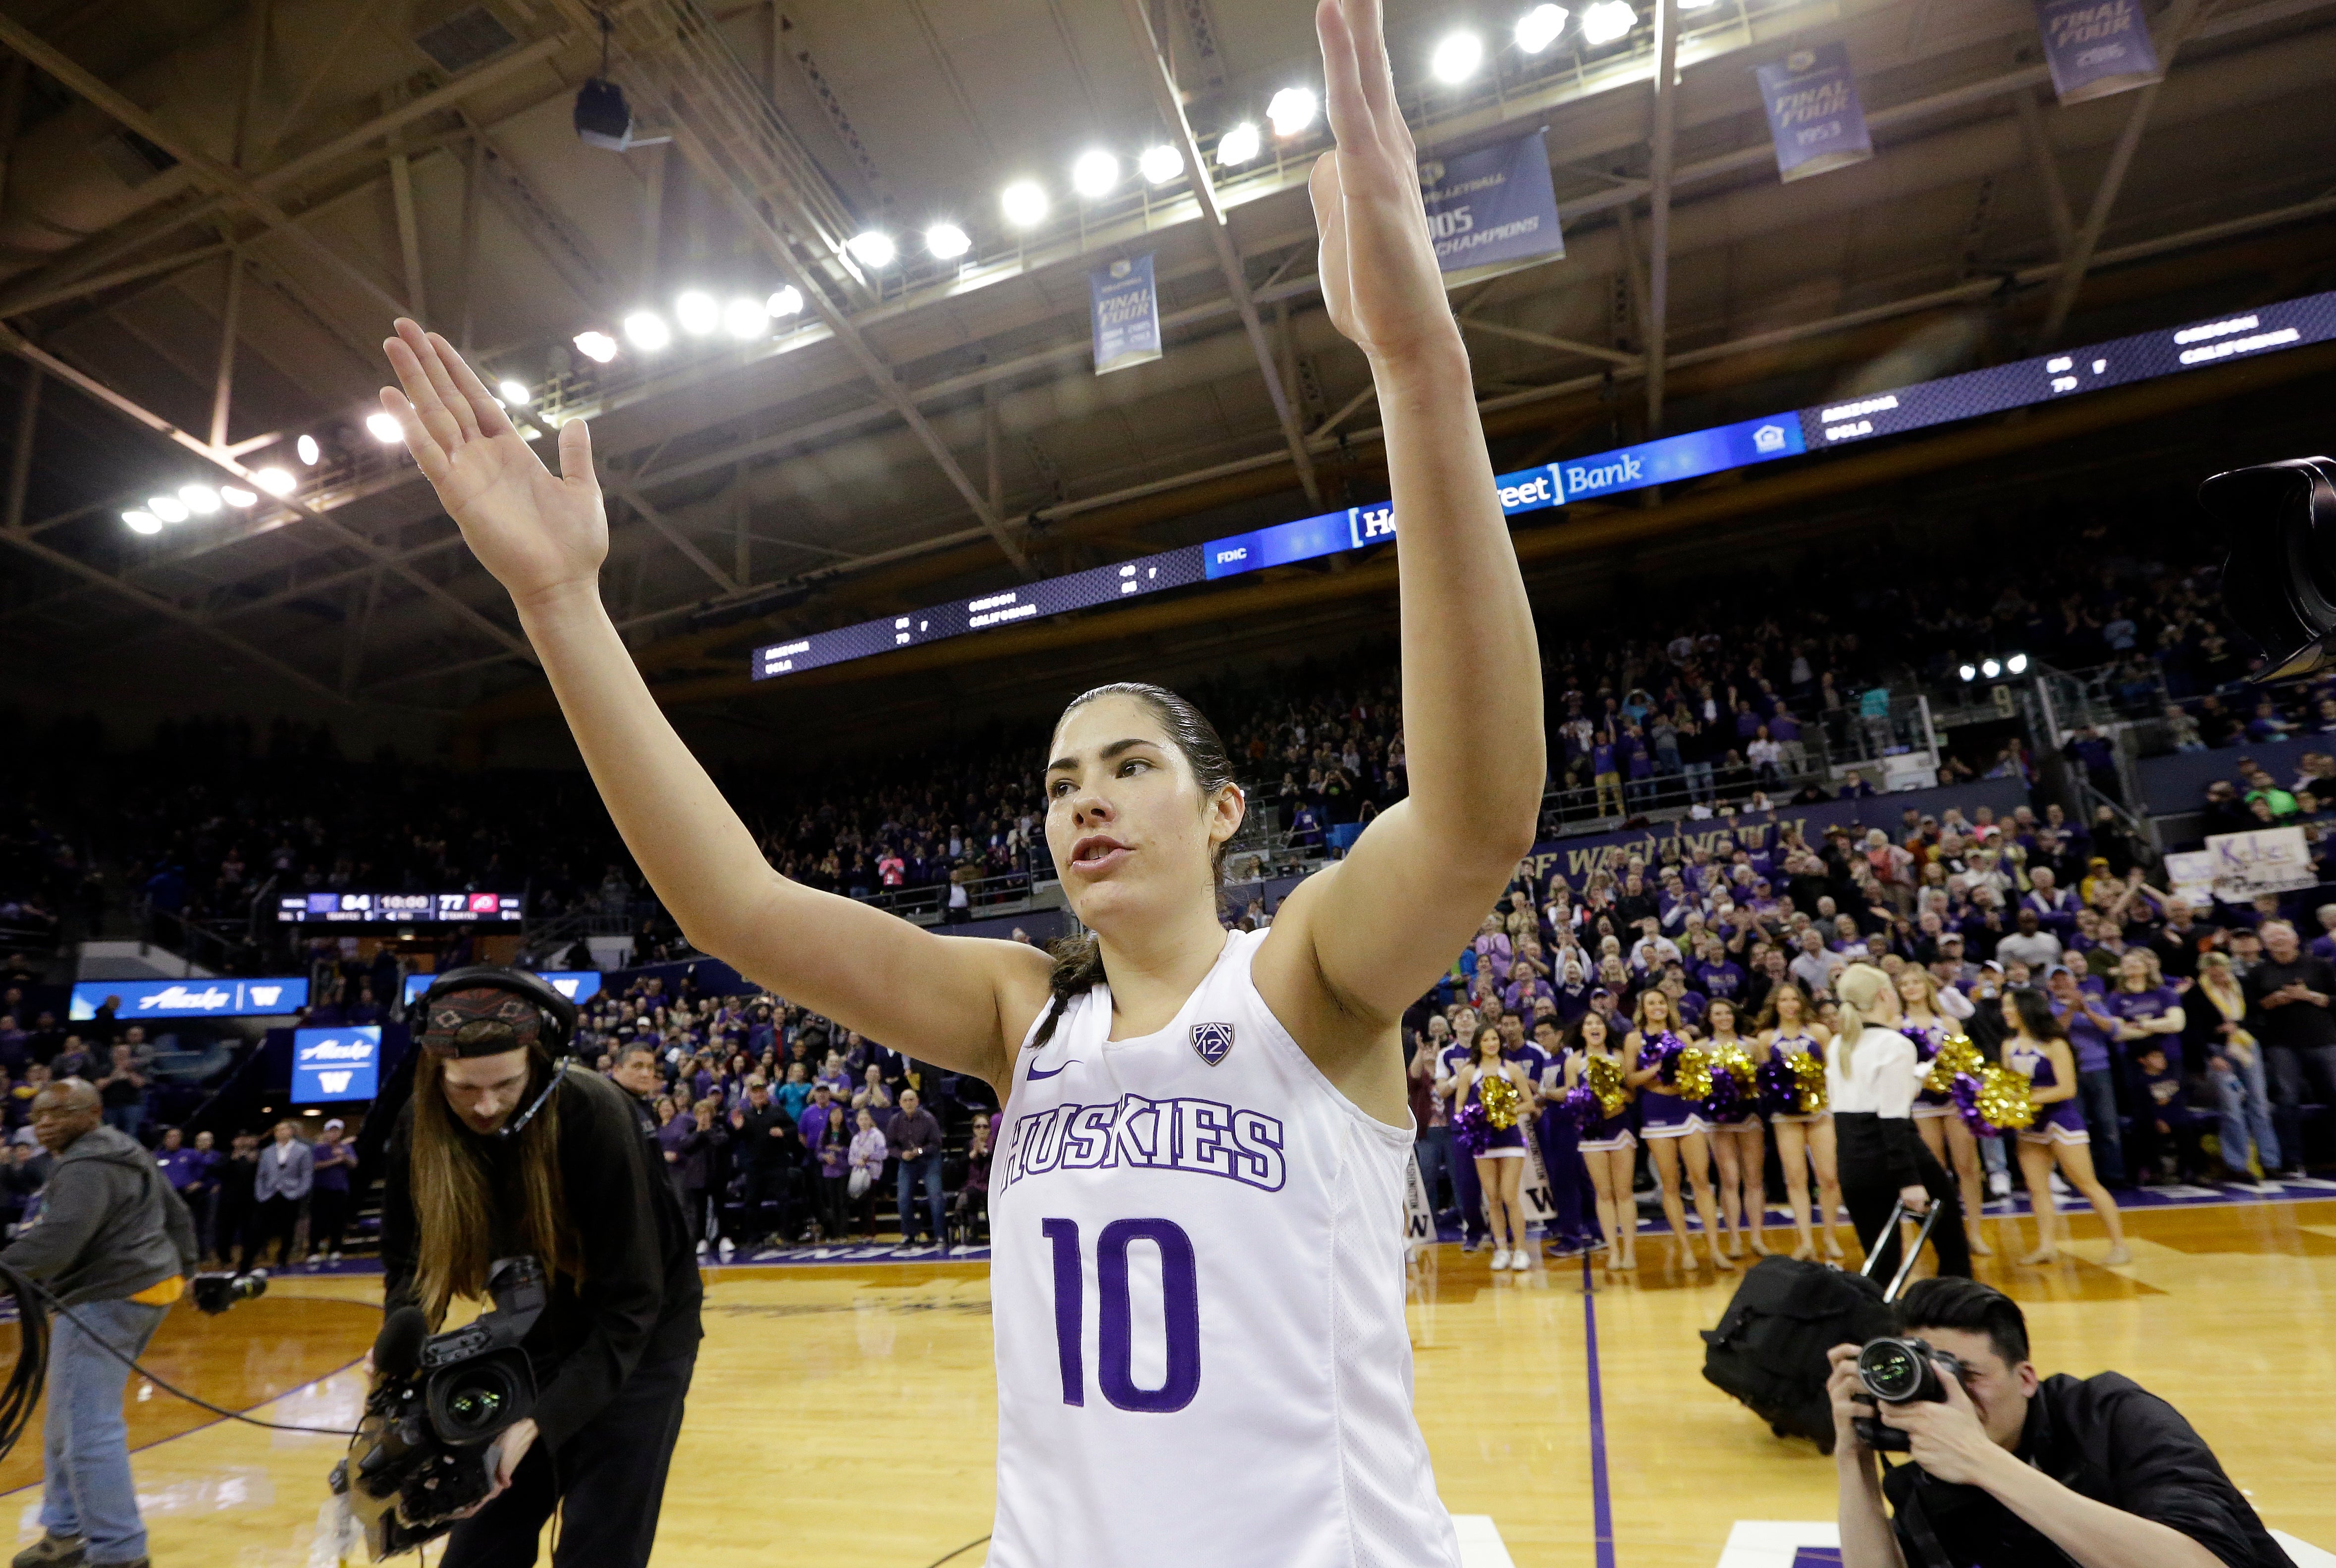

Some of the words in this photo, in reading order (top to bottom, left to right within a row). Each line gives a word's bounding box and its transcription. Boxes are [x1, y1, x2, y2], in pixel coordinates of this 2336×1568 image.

[1775, 80, 1850, 114] FINAL
[1781, 95, 1847, 127] FOUR
[1099, 288, 1150, 314] FINAL
[1825, 420, 1873, 441] UCLA
[1567, 454, 1642, 493] Bank
[1217, 547, 1247, 564] FDIC
[969, 592, 1016, 612] OREGON
[969, 604, 1036, 627] CALIFORNIA
[765, 641, 810, 660] ARIZONA
[765, 659, 793, 674] UCLA
[1992, 685, 2015, 719] 9
[341, 894, 371, 911] 84
[439, 894, 466, 910] 77
[138, 986, 230, 1010] Alaska
[1193, 1023, 1232, 1047] PAC
[1202, 1039, 1223, 1054] 12
[300, 1039, 373, 1061] Alaska
[318, 1070, 354, 1094] W
[1000, 1093, 1286, 1199] HUSKIES
[1042, 1217, 1201, 1414] 10
